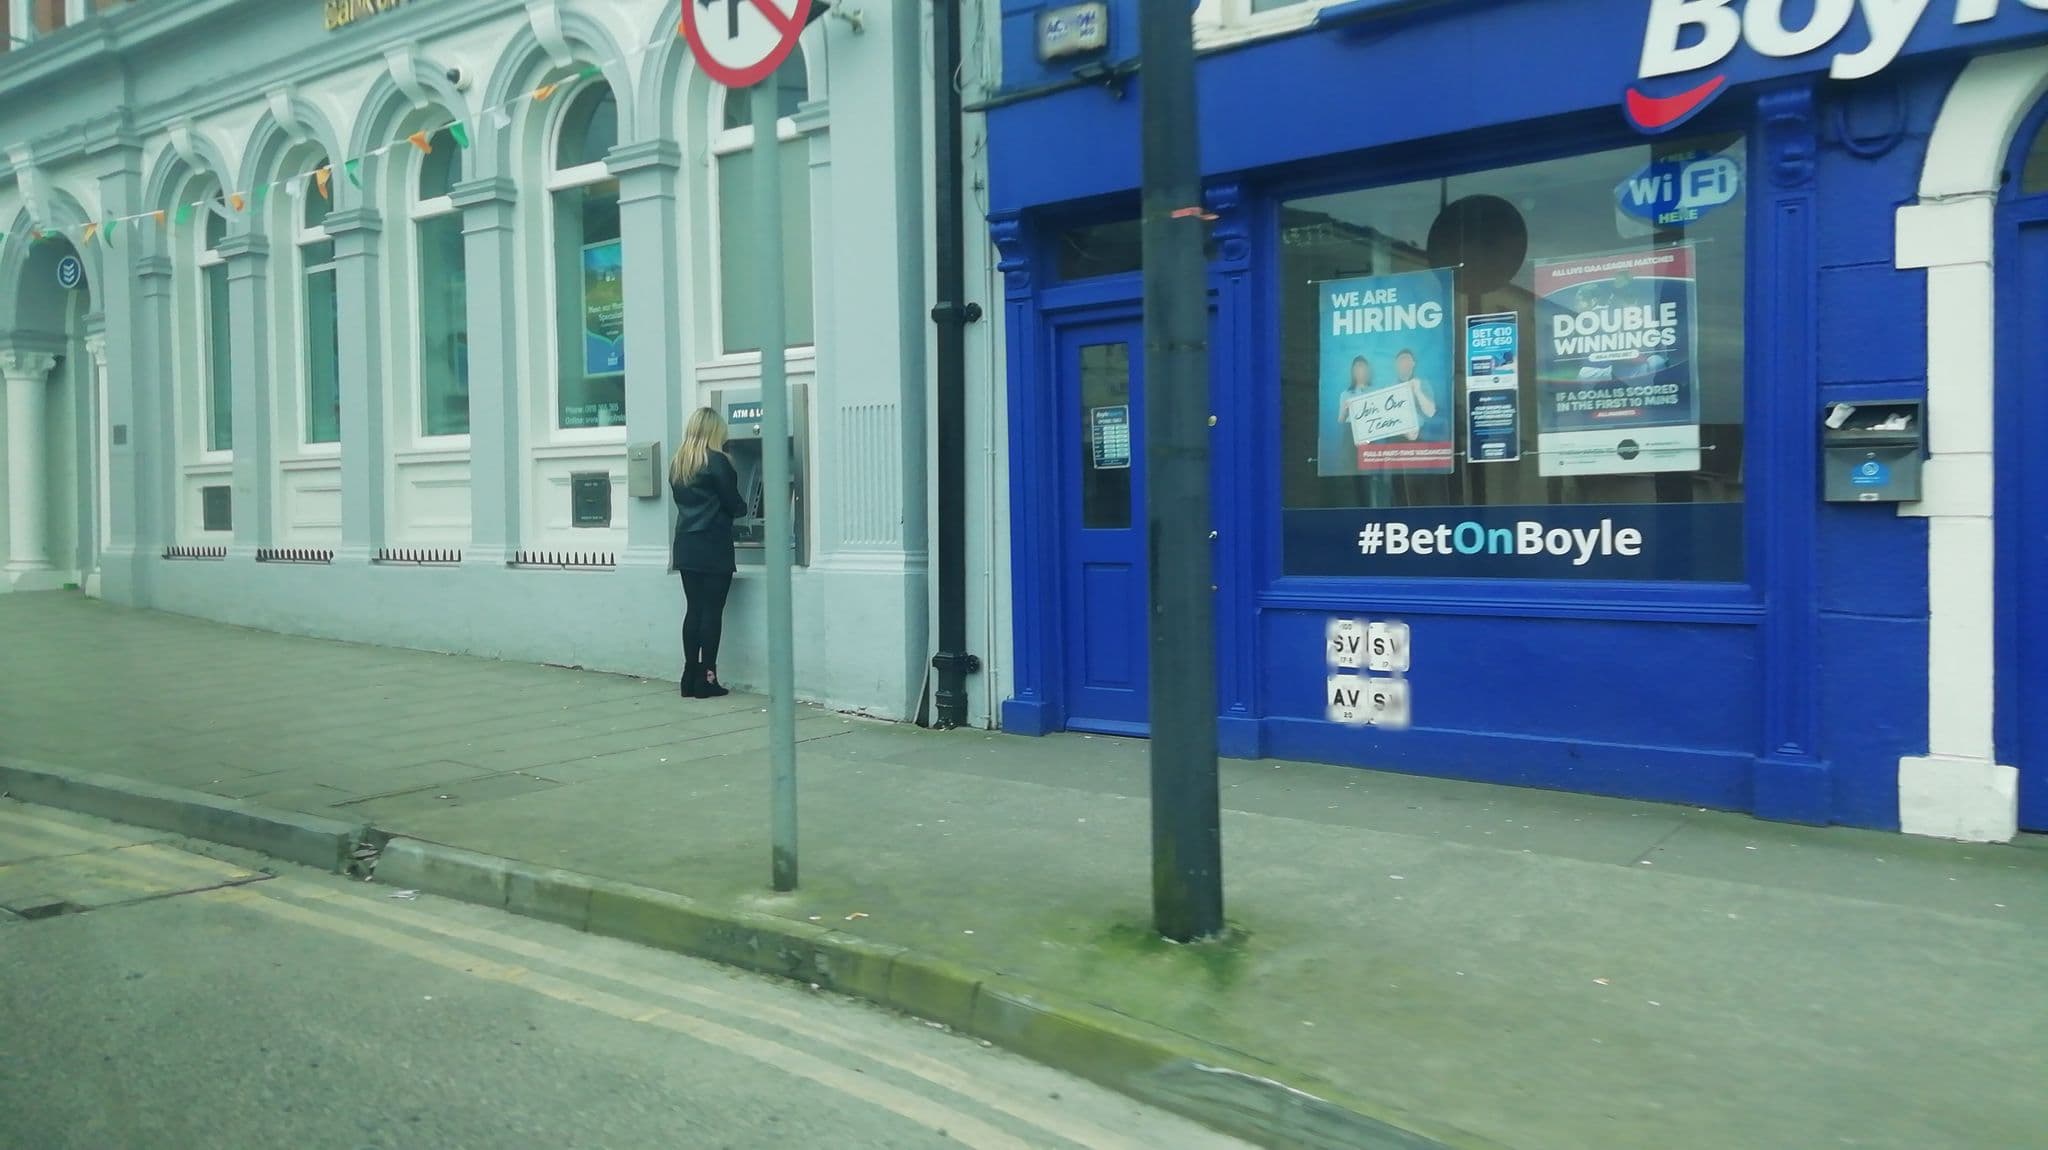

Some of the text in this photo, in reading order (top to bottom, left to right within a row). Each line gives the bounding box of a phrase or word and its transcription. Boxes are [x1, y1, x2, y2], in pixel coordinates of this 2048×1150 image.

[1638, 0, 2048, 79] Boy
[1332, 287, 1397, 308] WE ARE
[1332, 301, 1443, 336] HIRING
[1553, 302, 1678, 338] DOUBLE
[1472, 328, 1492, 338] BET
[1472, 338, 1492, 347] GET
[1553, 327, 1677, 356] WINNINGS
[1556, 384, 1679, 401] IF A GOAL IS SCORED
[1556, 394, 1679, 412] IN THE FIRST 10 MINS
[733, 409, 748, 418] ATM
[1355, 394, 1407, 420] Join Our
[1366, 418, 1402, 434] Team
[1358, 519, 1643, 566] #BetOnBoyle
